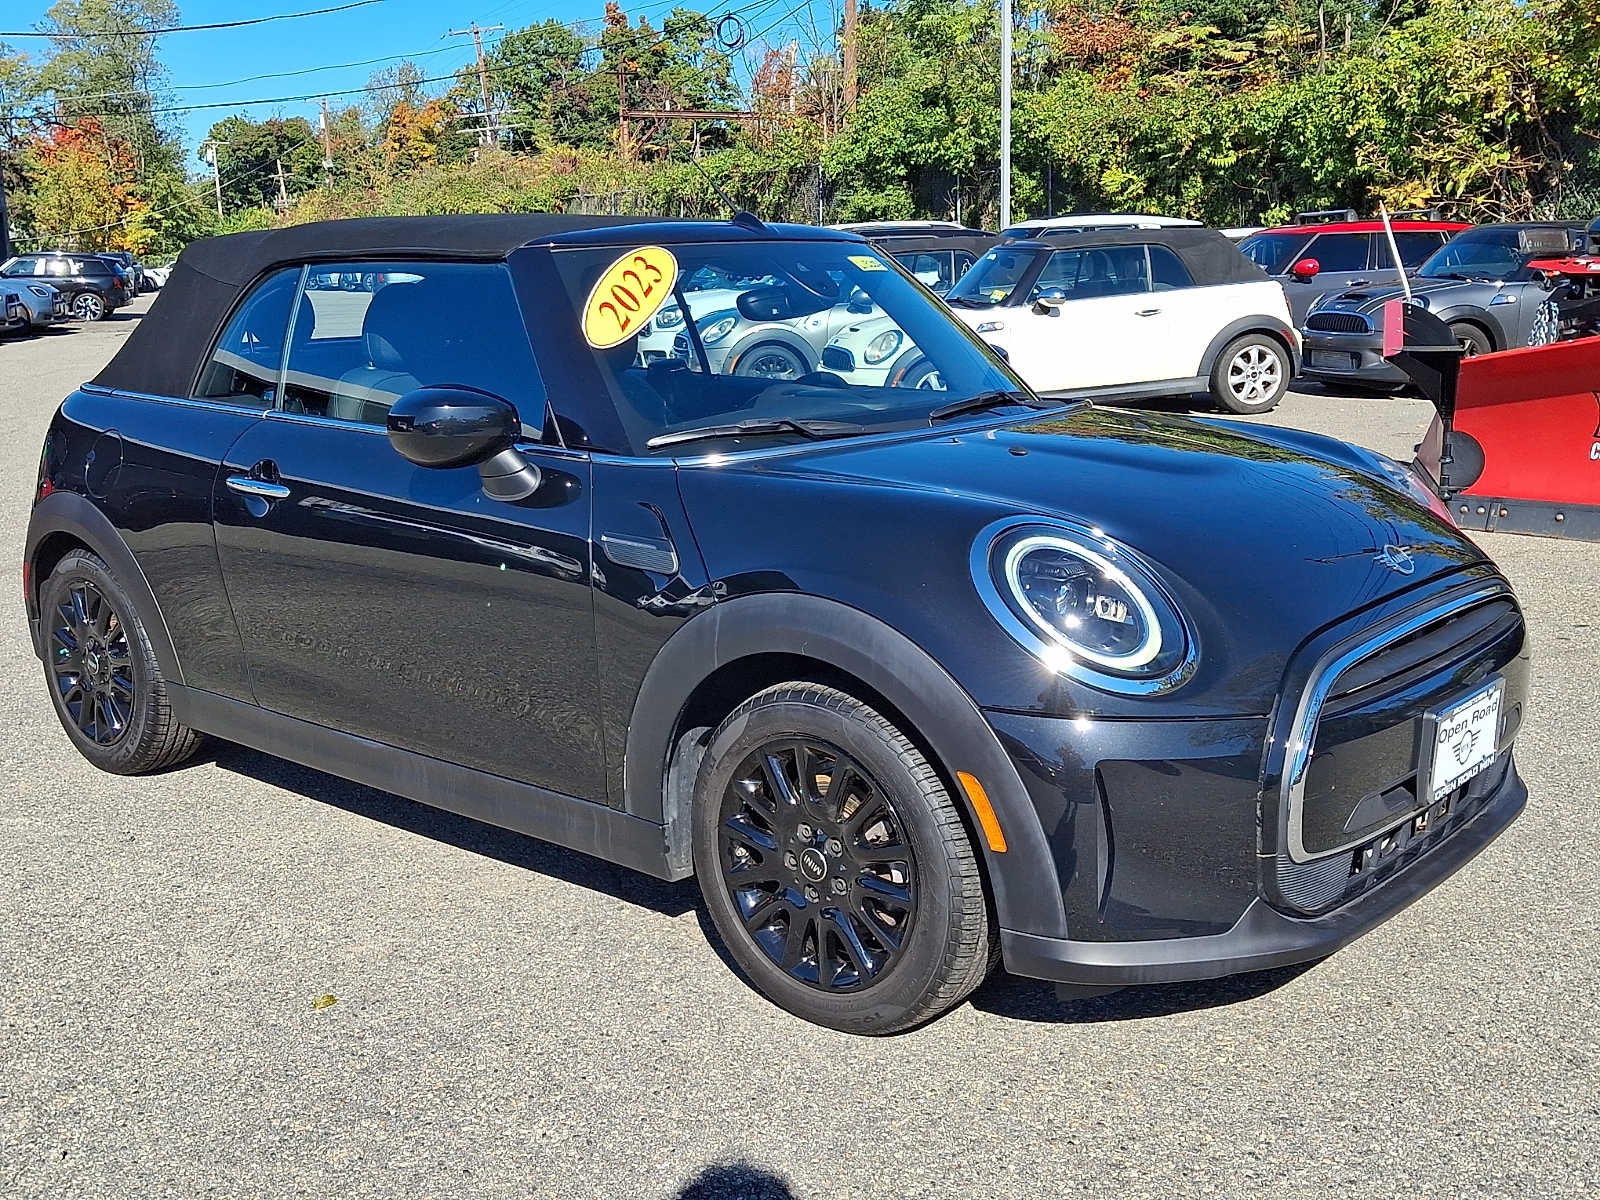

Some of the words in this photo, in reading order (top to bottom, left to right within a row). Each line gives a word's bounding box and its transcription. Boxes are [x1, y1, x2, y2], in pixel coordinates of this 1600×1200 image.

[599, 256, 662, 332] 2023
[1439, 719, 1468, 743] Open
[1472, 698, 1498, 724] Road
[803, 854, 822, 876] MINI
